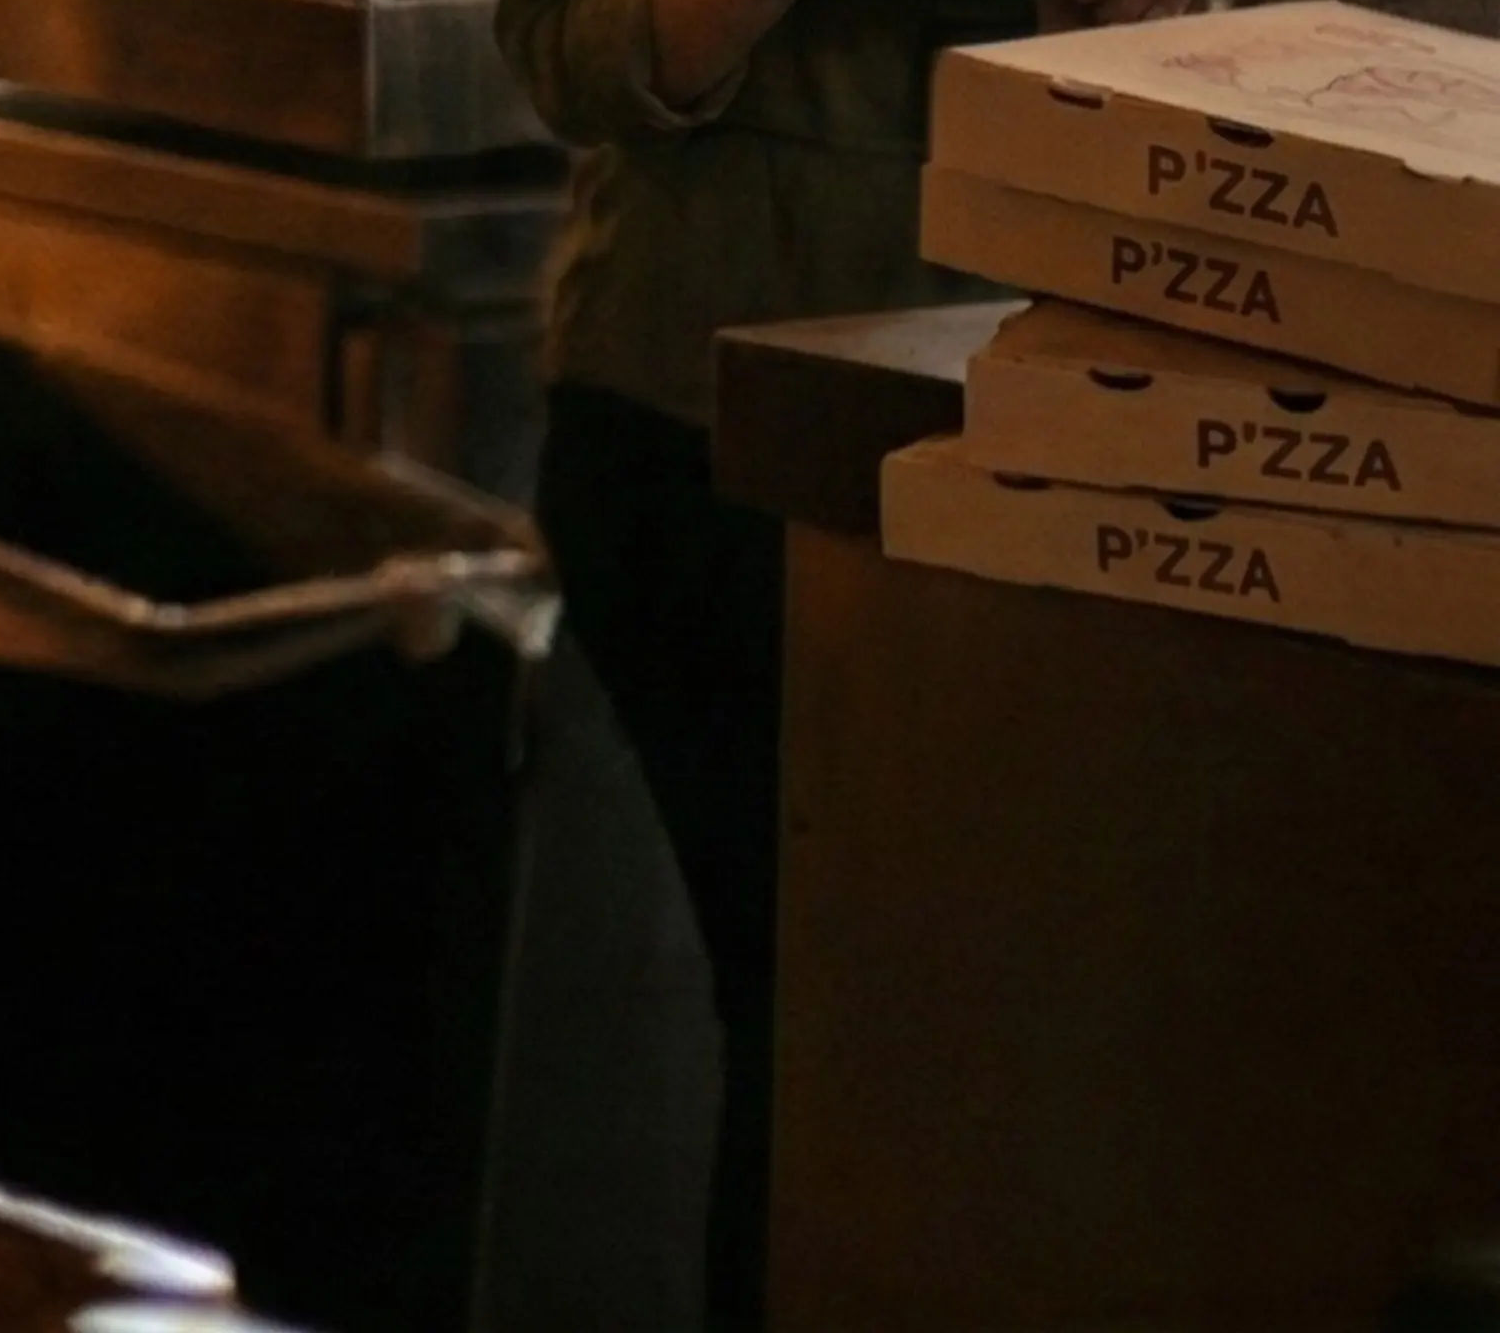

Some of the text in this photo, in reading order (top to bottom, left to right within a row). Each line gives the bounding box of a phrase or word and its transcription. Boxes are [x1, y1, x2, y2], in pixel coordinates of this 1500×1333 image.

[1148, 145, 1339, 238] P'ZZA
[1111, 237, 1281, 325] P'ZZA
[1196, 419, 1401, 491] P'ZZA
[1096, 525, 1281, 603] P'ZZA
